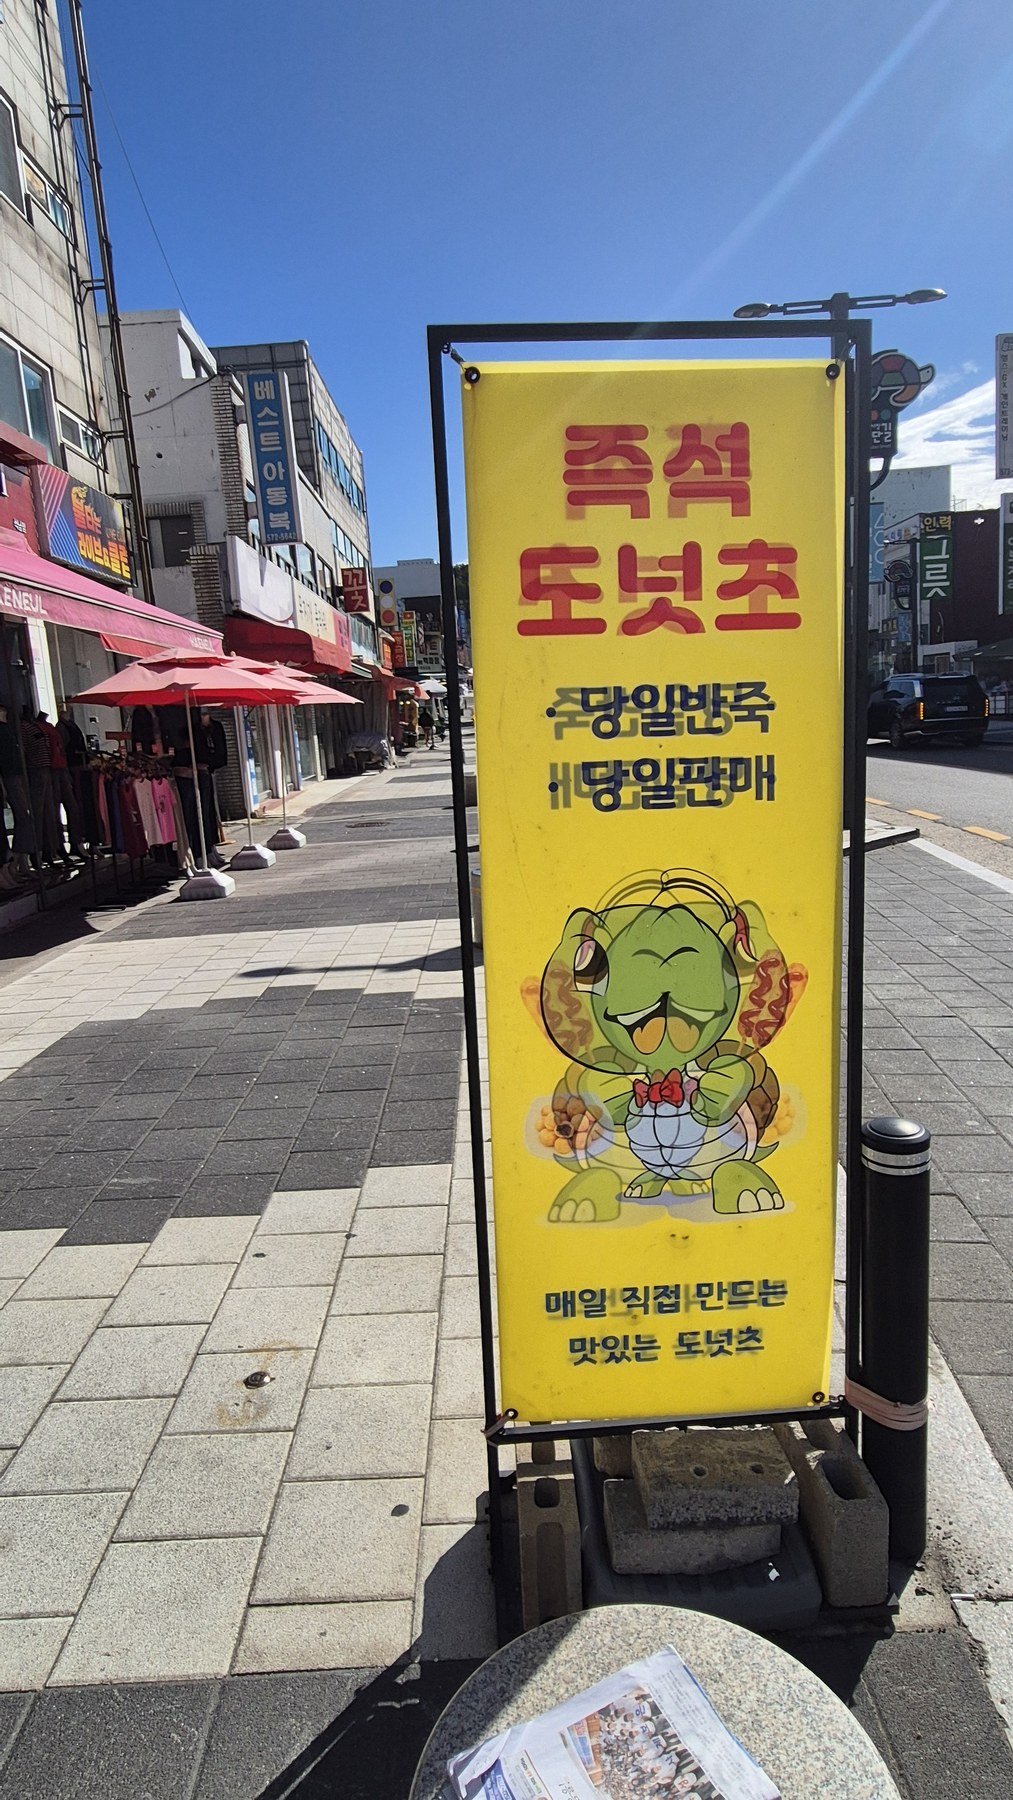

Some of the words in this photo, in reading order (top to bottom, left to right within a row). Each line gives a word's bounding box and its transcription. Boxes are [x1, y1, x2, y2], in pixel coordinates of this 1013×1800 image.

[254, 379, 282, 452] 베스트
[262, 461, 291, 530] 아동복
[563, 420, 751, 519] 즉석
[344, 569, 367, 610] 꽃
[922, 534, 951, 597] 그릇
[0, 586, 48, 614] ENEUL
[581, 682, 775, 740] 당일반죽
[582, 755, 776, 812] 당일판매
[545, 1288, 606, 1319] 매일
[622, 1284, 681, 1315] 직접
[696, 1279, 788, 1312] 만드는
[569, 1334, 661, 1366] 맛있는
[675, 1326, 764, 1358] 도넛츠
